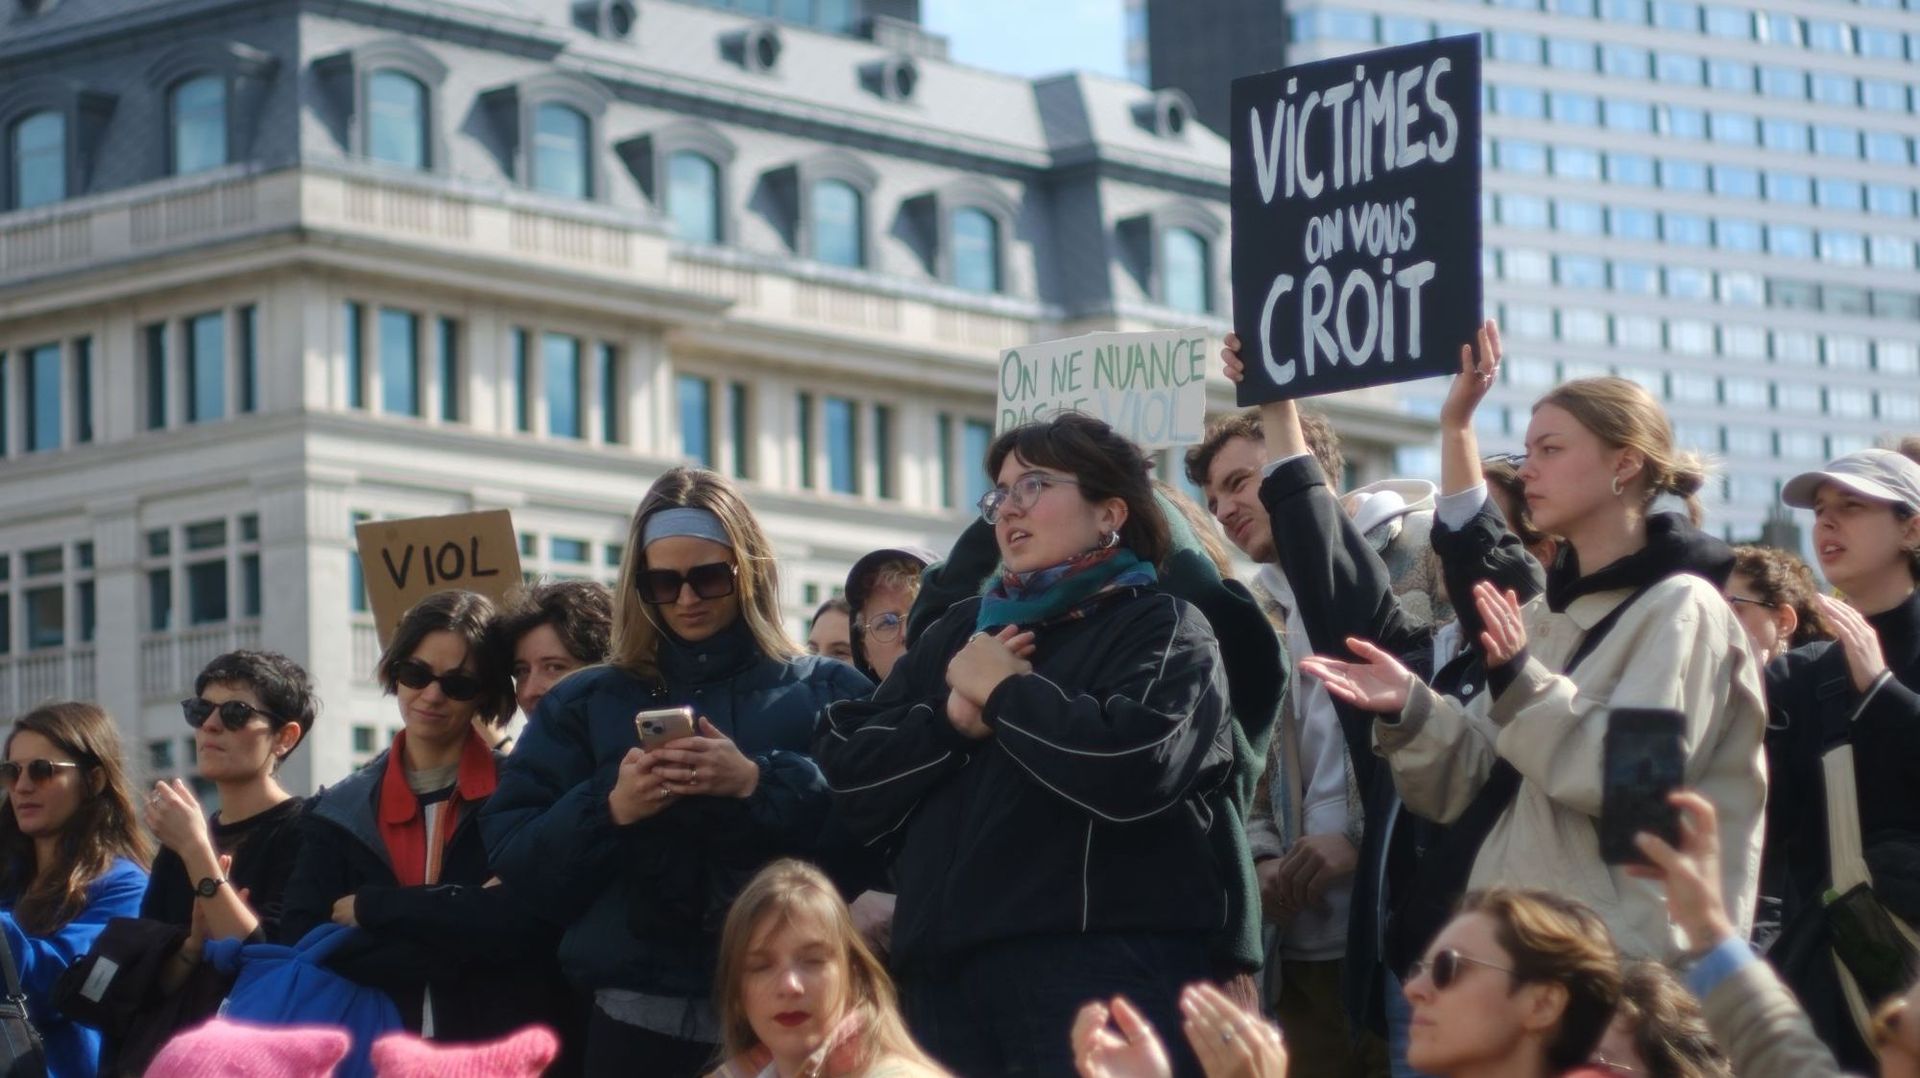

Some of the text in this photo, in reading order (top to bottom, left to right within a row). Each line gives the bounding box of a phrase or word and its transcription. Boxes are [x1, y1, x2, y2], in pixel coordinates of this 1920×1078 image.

[1304, 196, 1417, 265] ON VOUS
[1001, 338, 1206, 401] ON NE NUANCE
[1099, 388, 1201, 444] VIOL
[381, 535, 499, 590] VIOL
